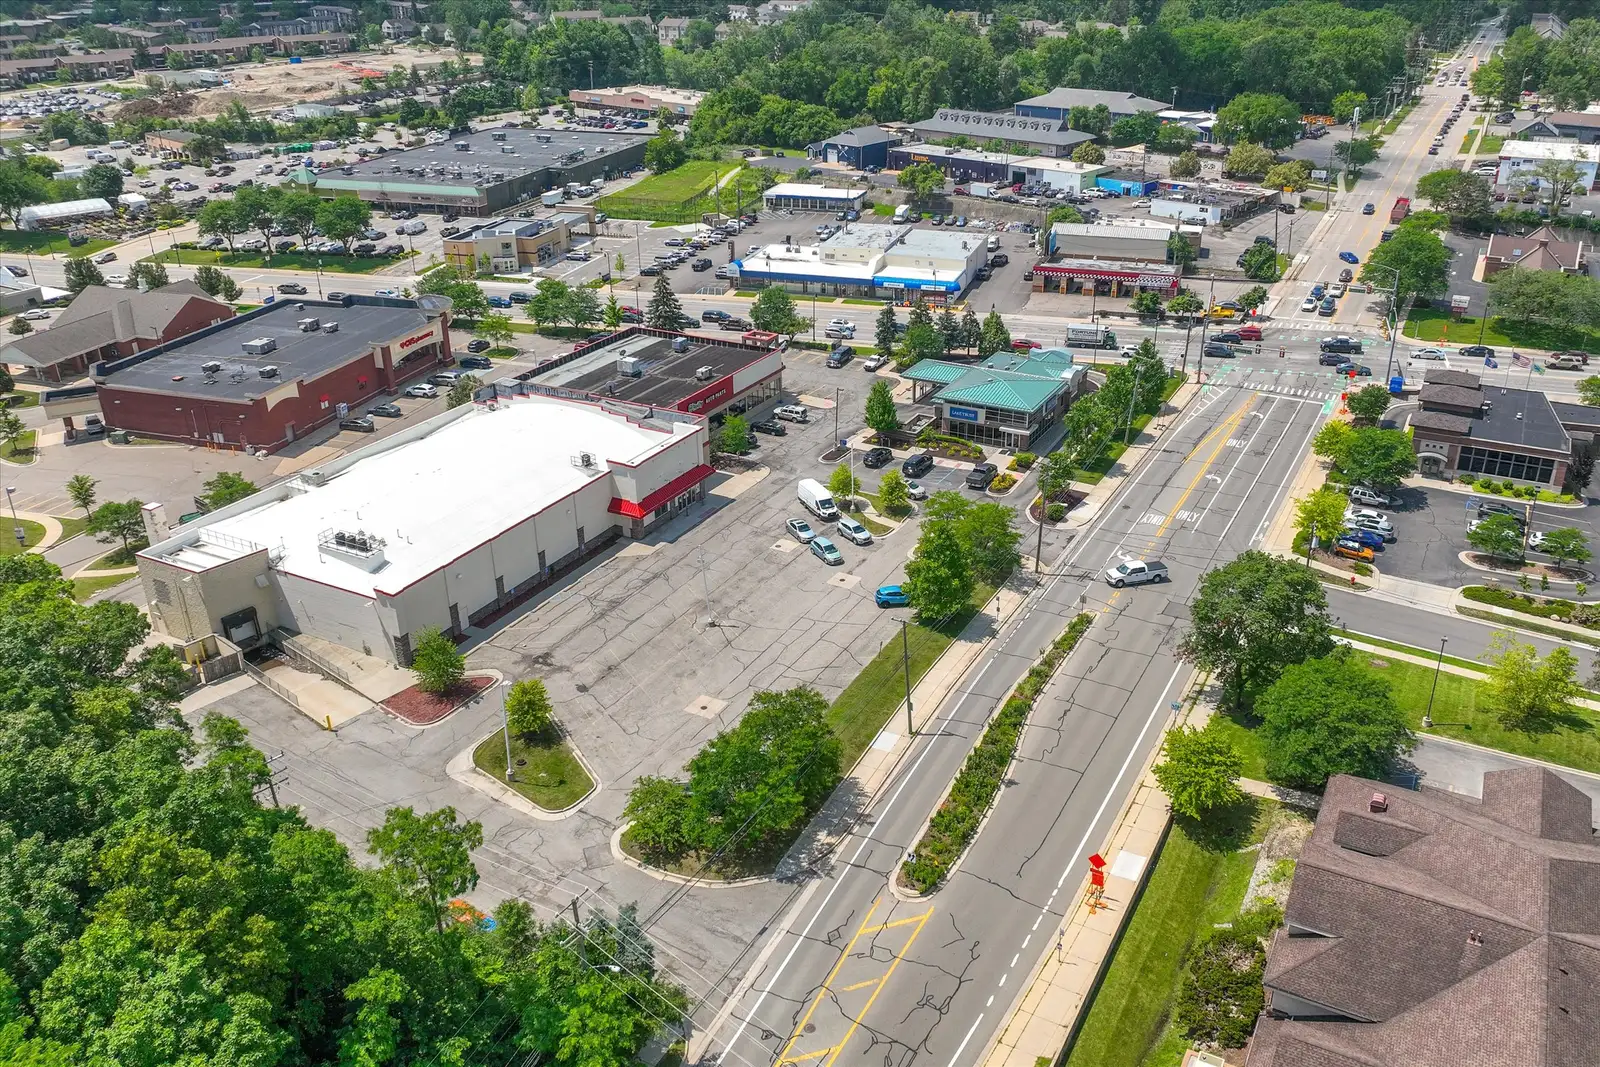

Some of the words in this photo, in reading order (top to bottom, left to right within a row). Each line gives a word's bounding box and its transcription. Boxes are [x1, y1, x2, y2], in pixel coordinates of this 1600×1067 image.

[1226, 438, 1247, 448] ONLY
[1140, 513, 1166, 525] ONLY
[1176, 510, 1200, 522] ONLY
